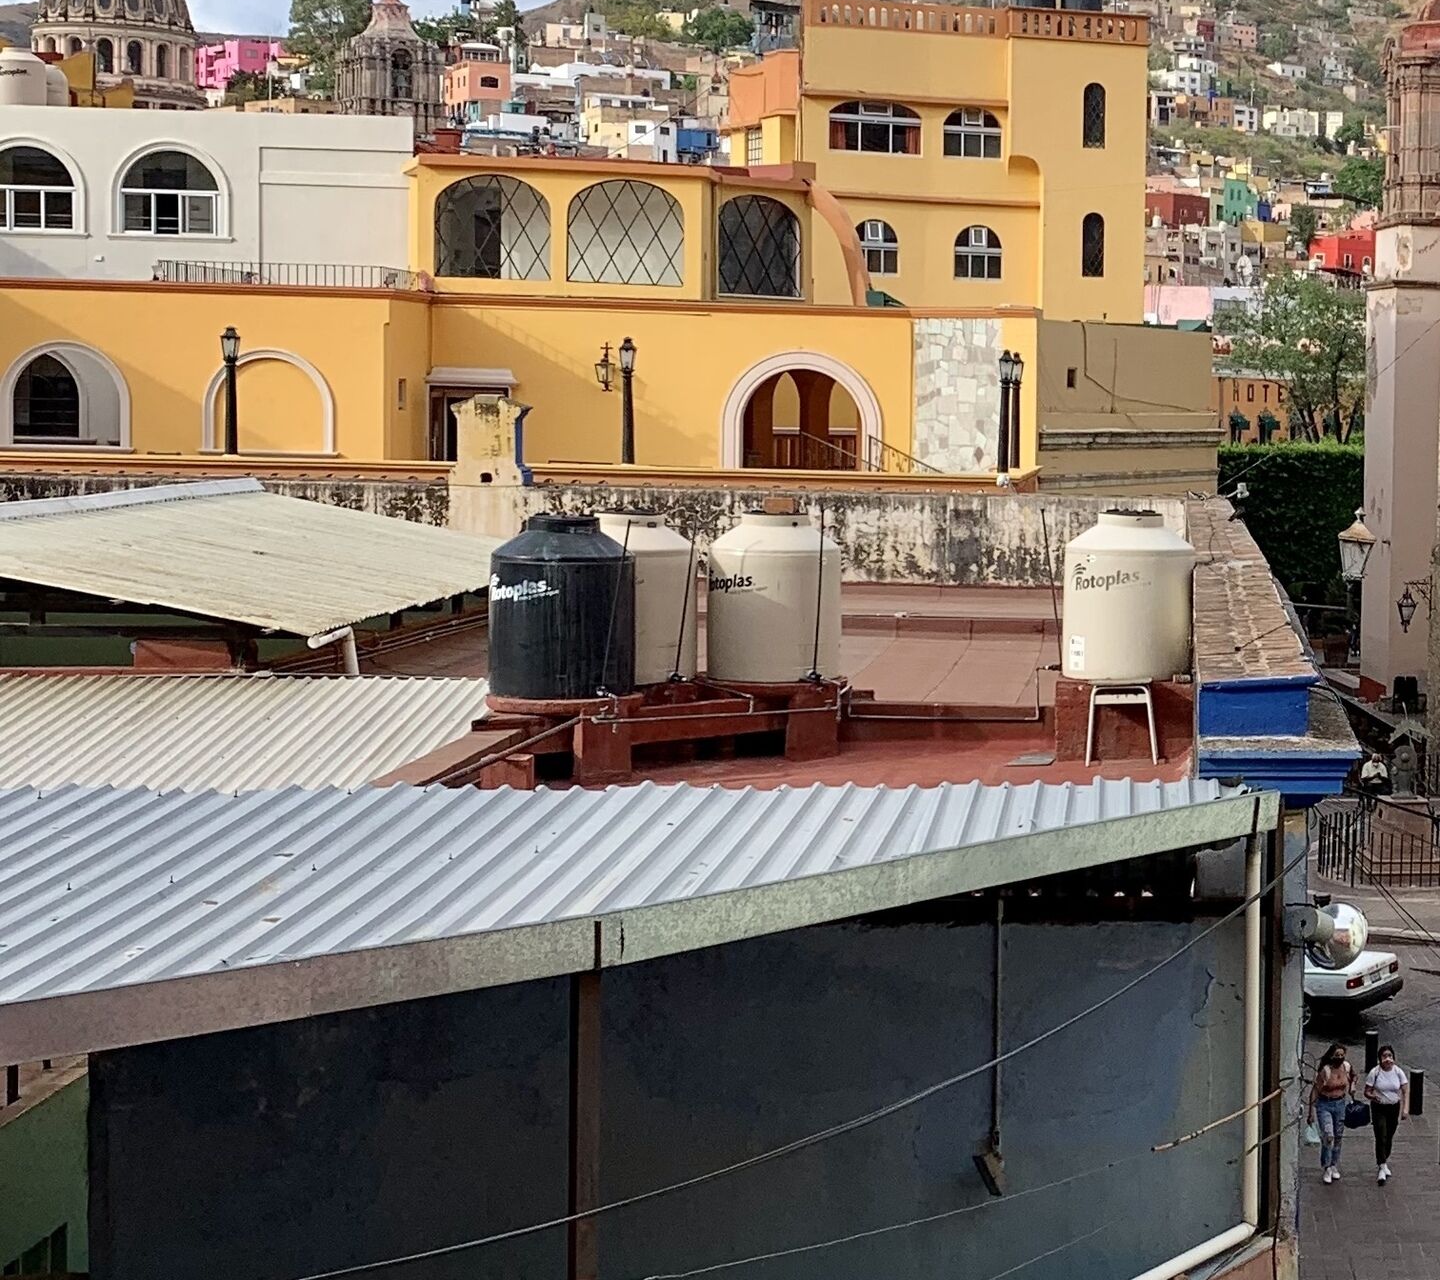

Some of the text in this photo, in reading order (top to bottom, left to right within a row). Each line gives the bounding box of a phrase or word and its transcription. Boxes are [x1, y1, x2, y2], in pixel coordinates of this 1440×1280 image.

[1233, 379, 1287, 403] HOTE
[709, 573, 753, 594] otoplas
[1075, 570, 1140, 591] Rotoplas
